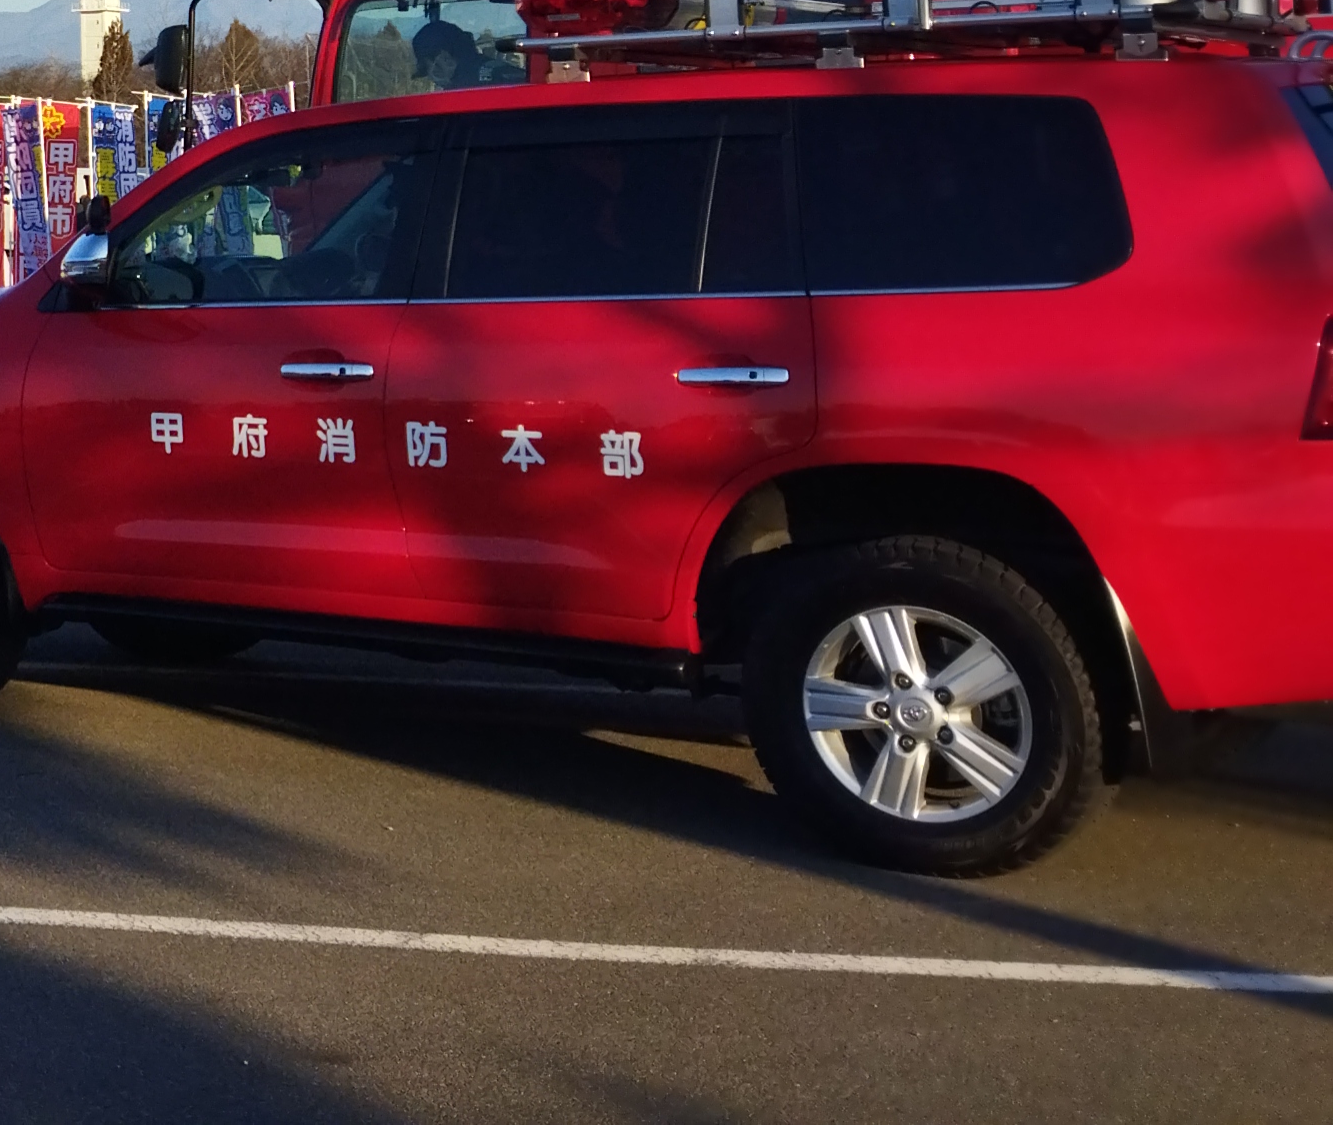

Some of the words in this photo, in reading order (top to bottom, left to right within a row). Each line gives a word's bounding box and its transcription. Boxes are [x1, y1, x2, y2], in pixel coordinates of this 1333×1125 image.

[48, 142, 74, 235] 甲府市
[149, 411, 644, 479] 甲府消防本部
